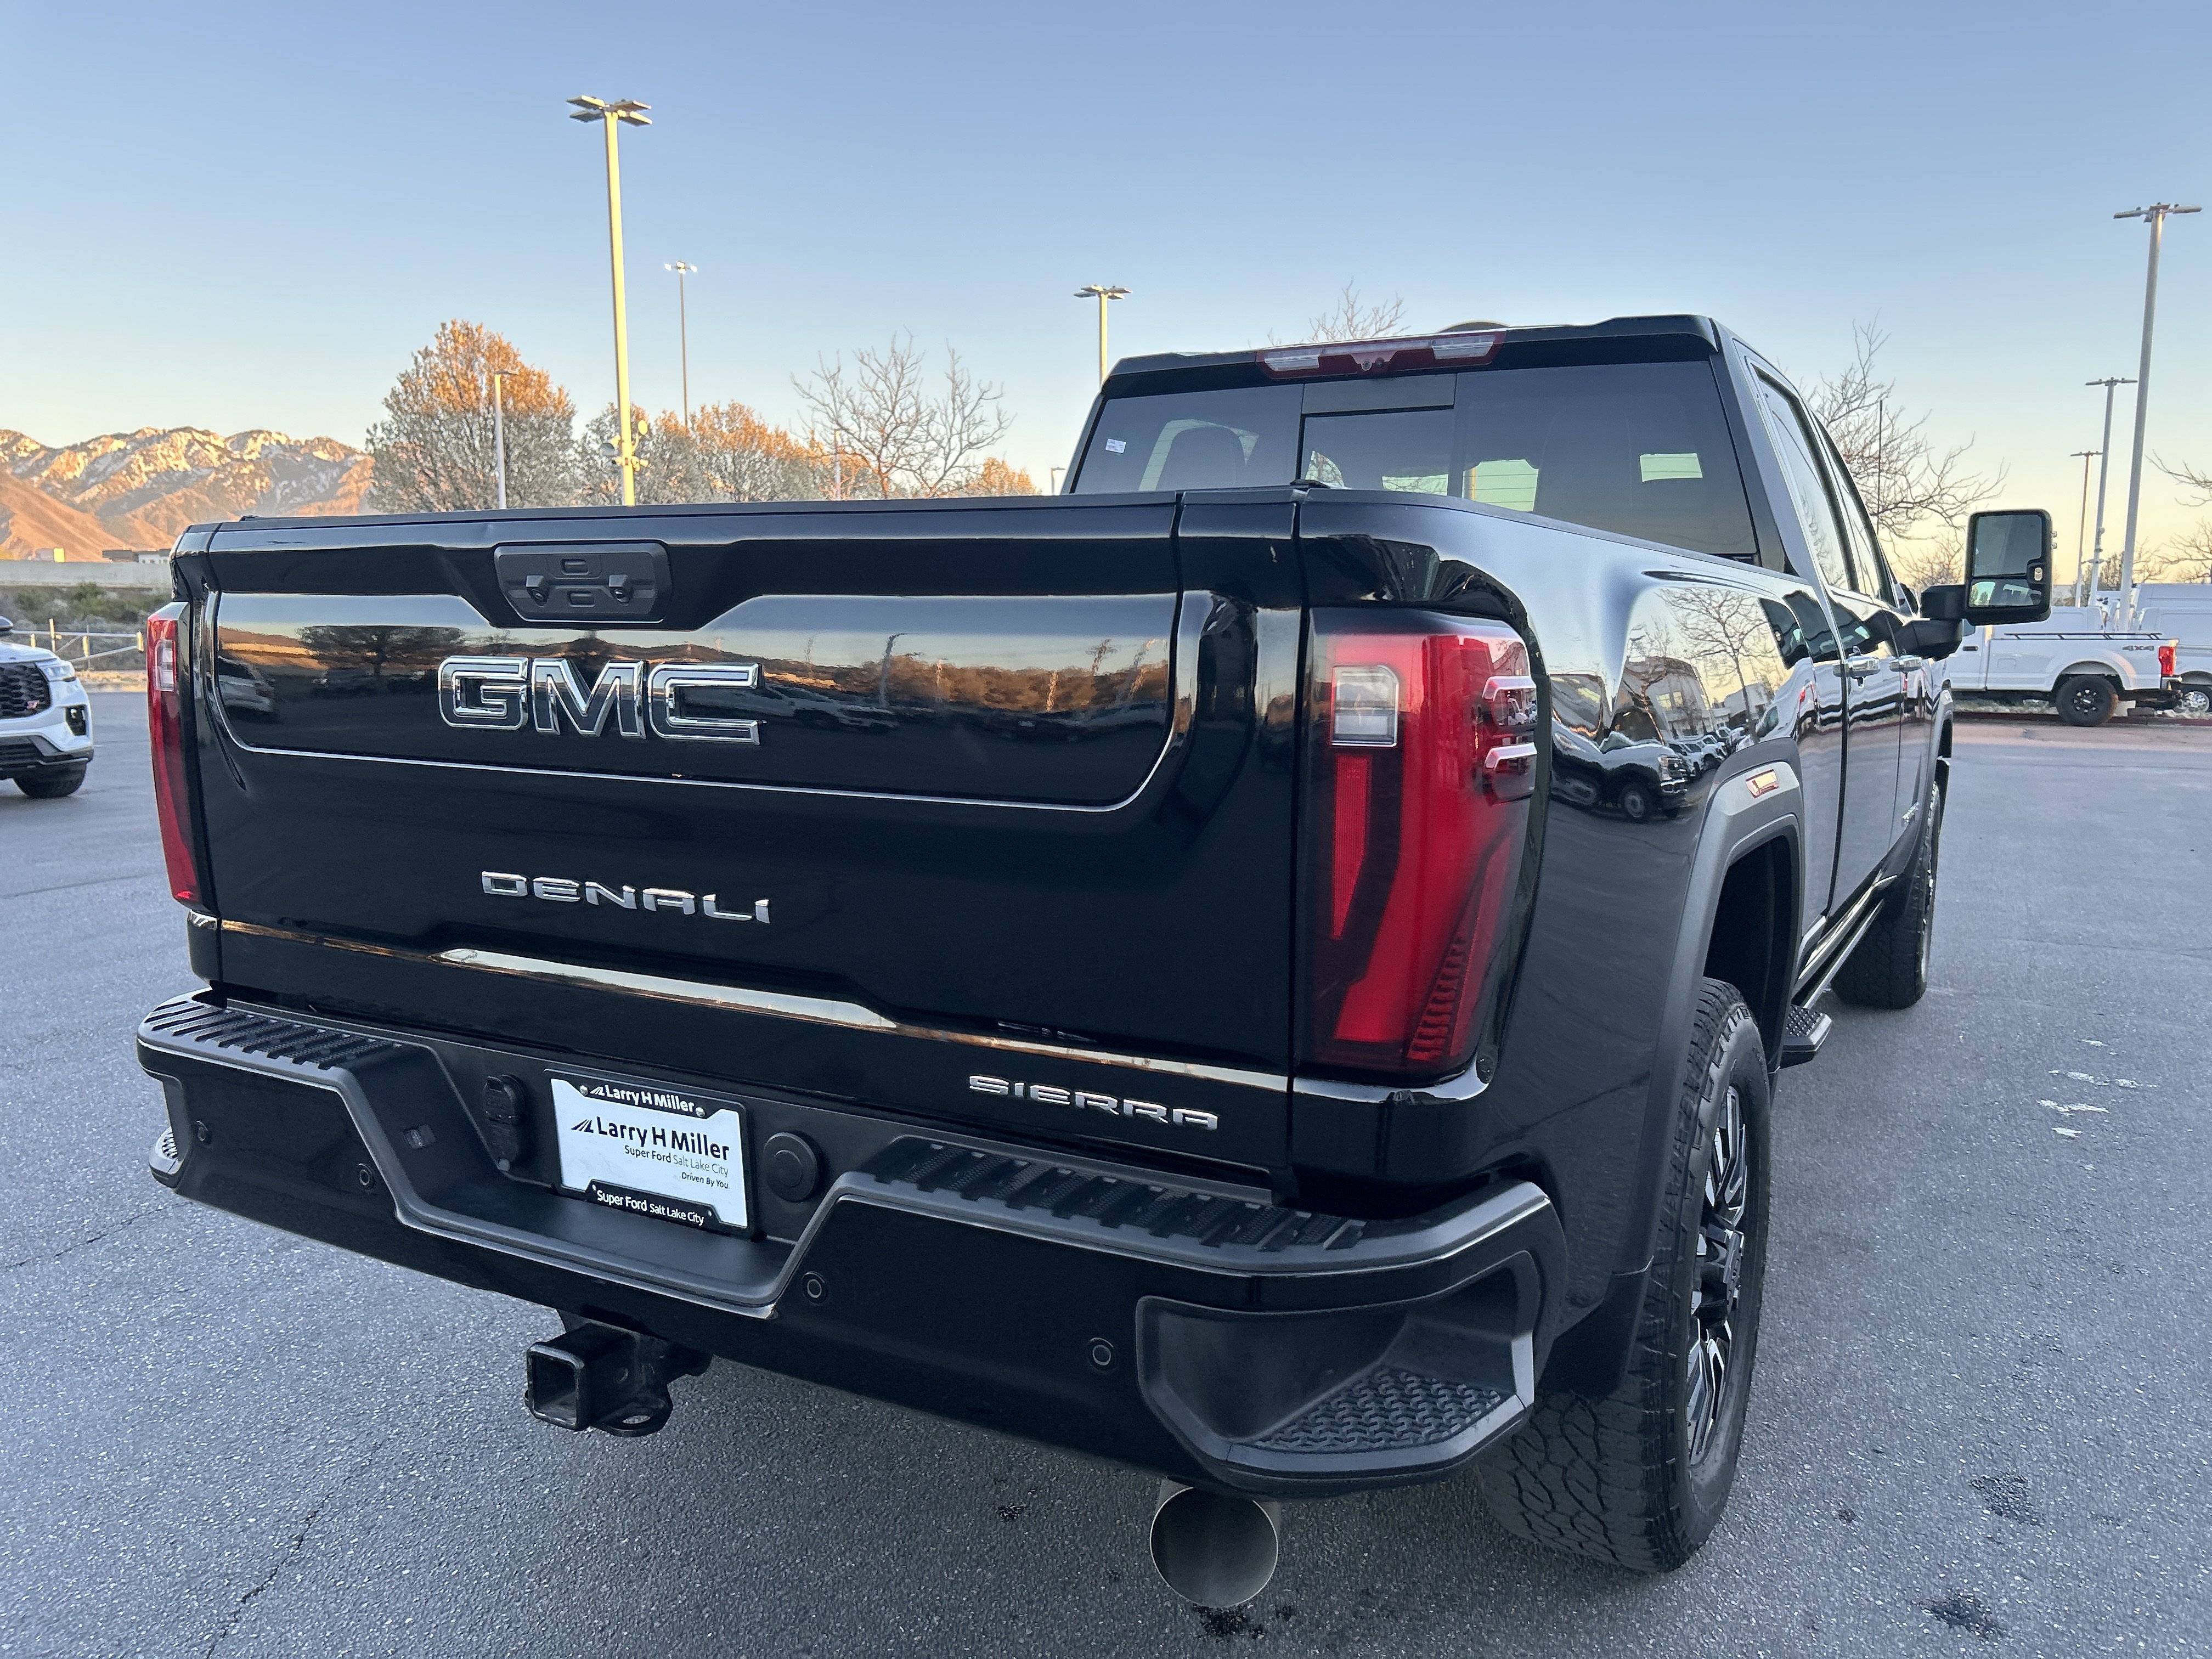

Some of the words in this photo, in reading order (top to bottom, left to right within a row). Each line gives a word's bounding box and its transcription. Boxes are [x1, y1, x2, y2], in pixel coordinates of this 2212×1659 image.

[438, 656, 763, 746] GMC
[482, 871, 770, 923] DENALI
[605, 1085, 639, 1105] Larry
[641, 1091, 653, 1105] H
[654, 1093, 695, 1113] Miller
[969, 1075, 1218, 1130] SIERRA
[596, 1116, 647, 1147] Larry
[652, 1126, 667, 1147] H
[672, 1130, 730, 1160] Miller
[624, 1145, 650, 1158] Super
[652, 1150, 671, 1163] Ford
[673, 1155, 689, 1167] Salt
[691, 1158, 710, 1171] Lake
[712, 1164, 729, 1178] City
[681, 1172, 704, 1183] Driven
[706, 1177, 714, 1187] By
[716, 1180, 730, 1189] You.
[597, 1190, 623, 1206] Super
[625, 1196, 647, 1211] Ford
[650, 1203, 665, 1216] Salt
[667, 1207, 686, 1220] Lake
[687, 1211, 704, 1226] City
